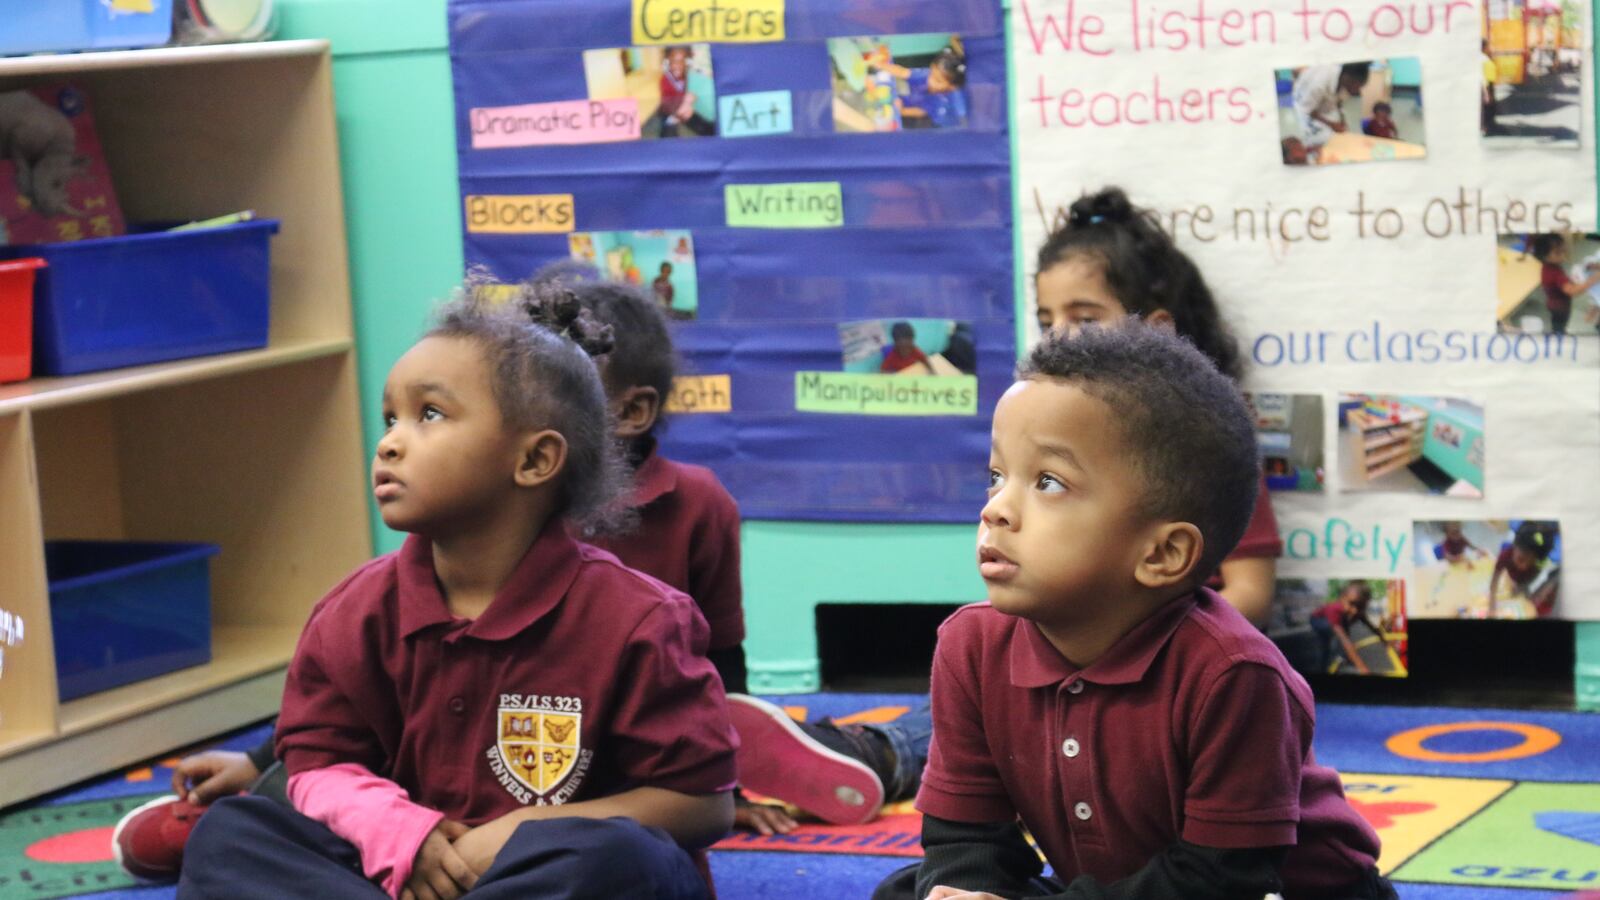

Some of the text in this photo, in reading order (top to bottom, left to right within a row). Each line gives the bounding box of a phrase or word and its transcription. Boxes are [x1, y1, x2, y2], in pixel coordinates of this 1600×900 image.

[641, 0, 777, 41] Centers
[1020, 0, 1473, 56] We listen to our
[473, 101, 638, 135] Dramatic Play
[727, 100, 782, 130] Art
[1029, 74, 1267, 128] teachers.
[470, 197, 572, 226] Blocks
[734, 186, 841, 224] Writing
[1232, 199, 1331, 243] nice
[1350, 190, 1404, 240] to
[1252, 320, 1578, 367] our classroom
[801, 372, 972, 409] Manipulatives
[485, 744, 533, 805] WINNERS
[550, 748, 594, 807] ACHIEVERS
